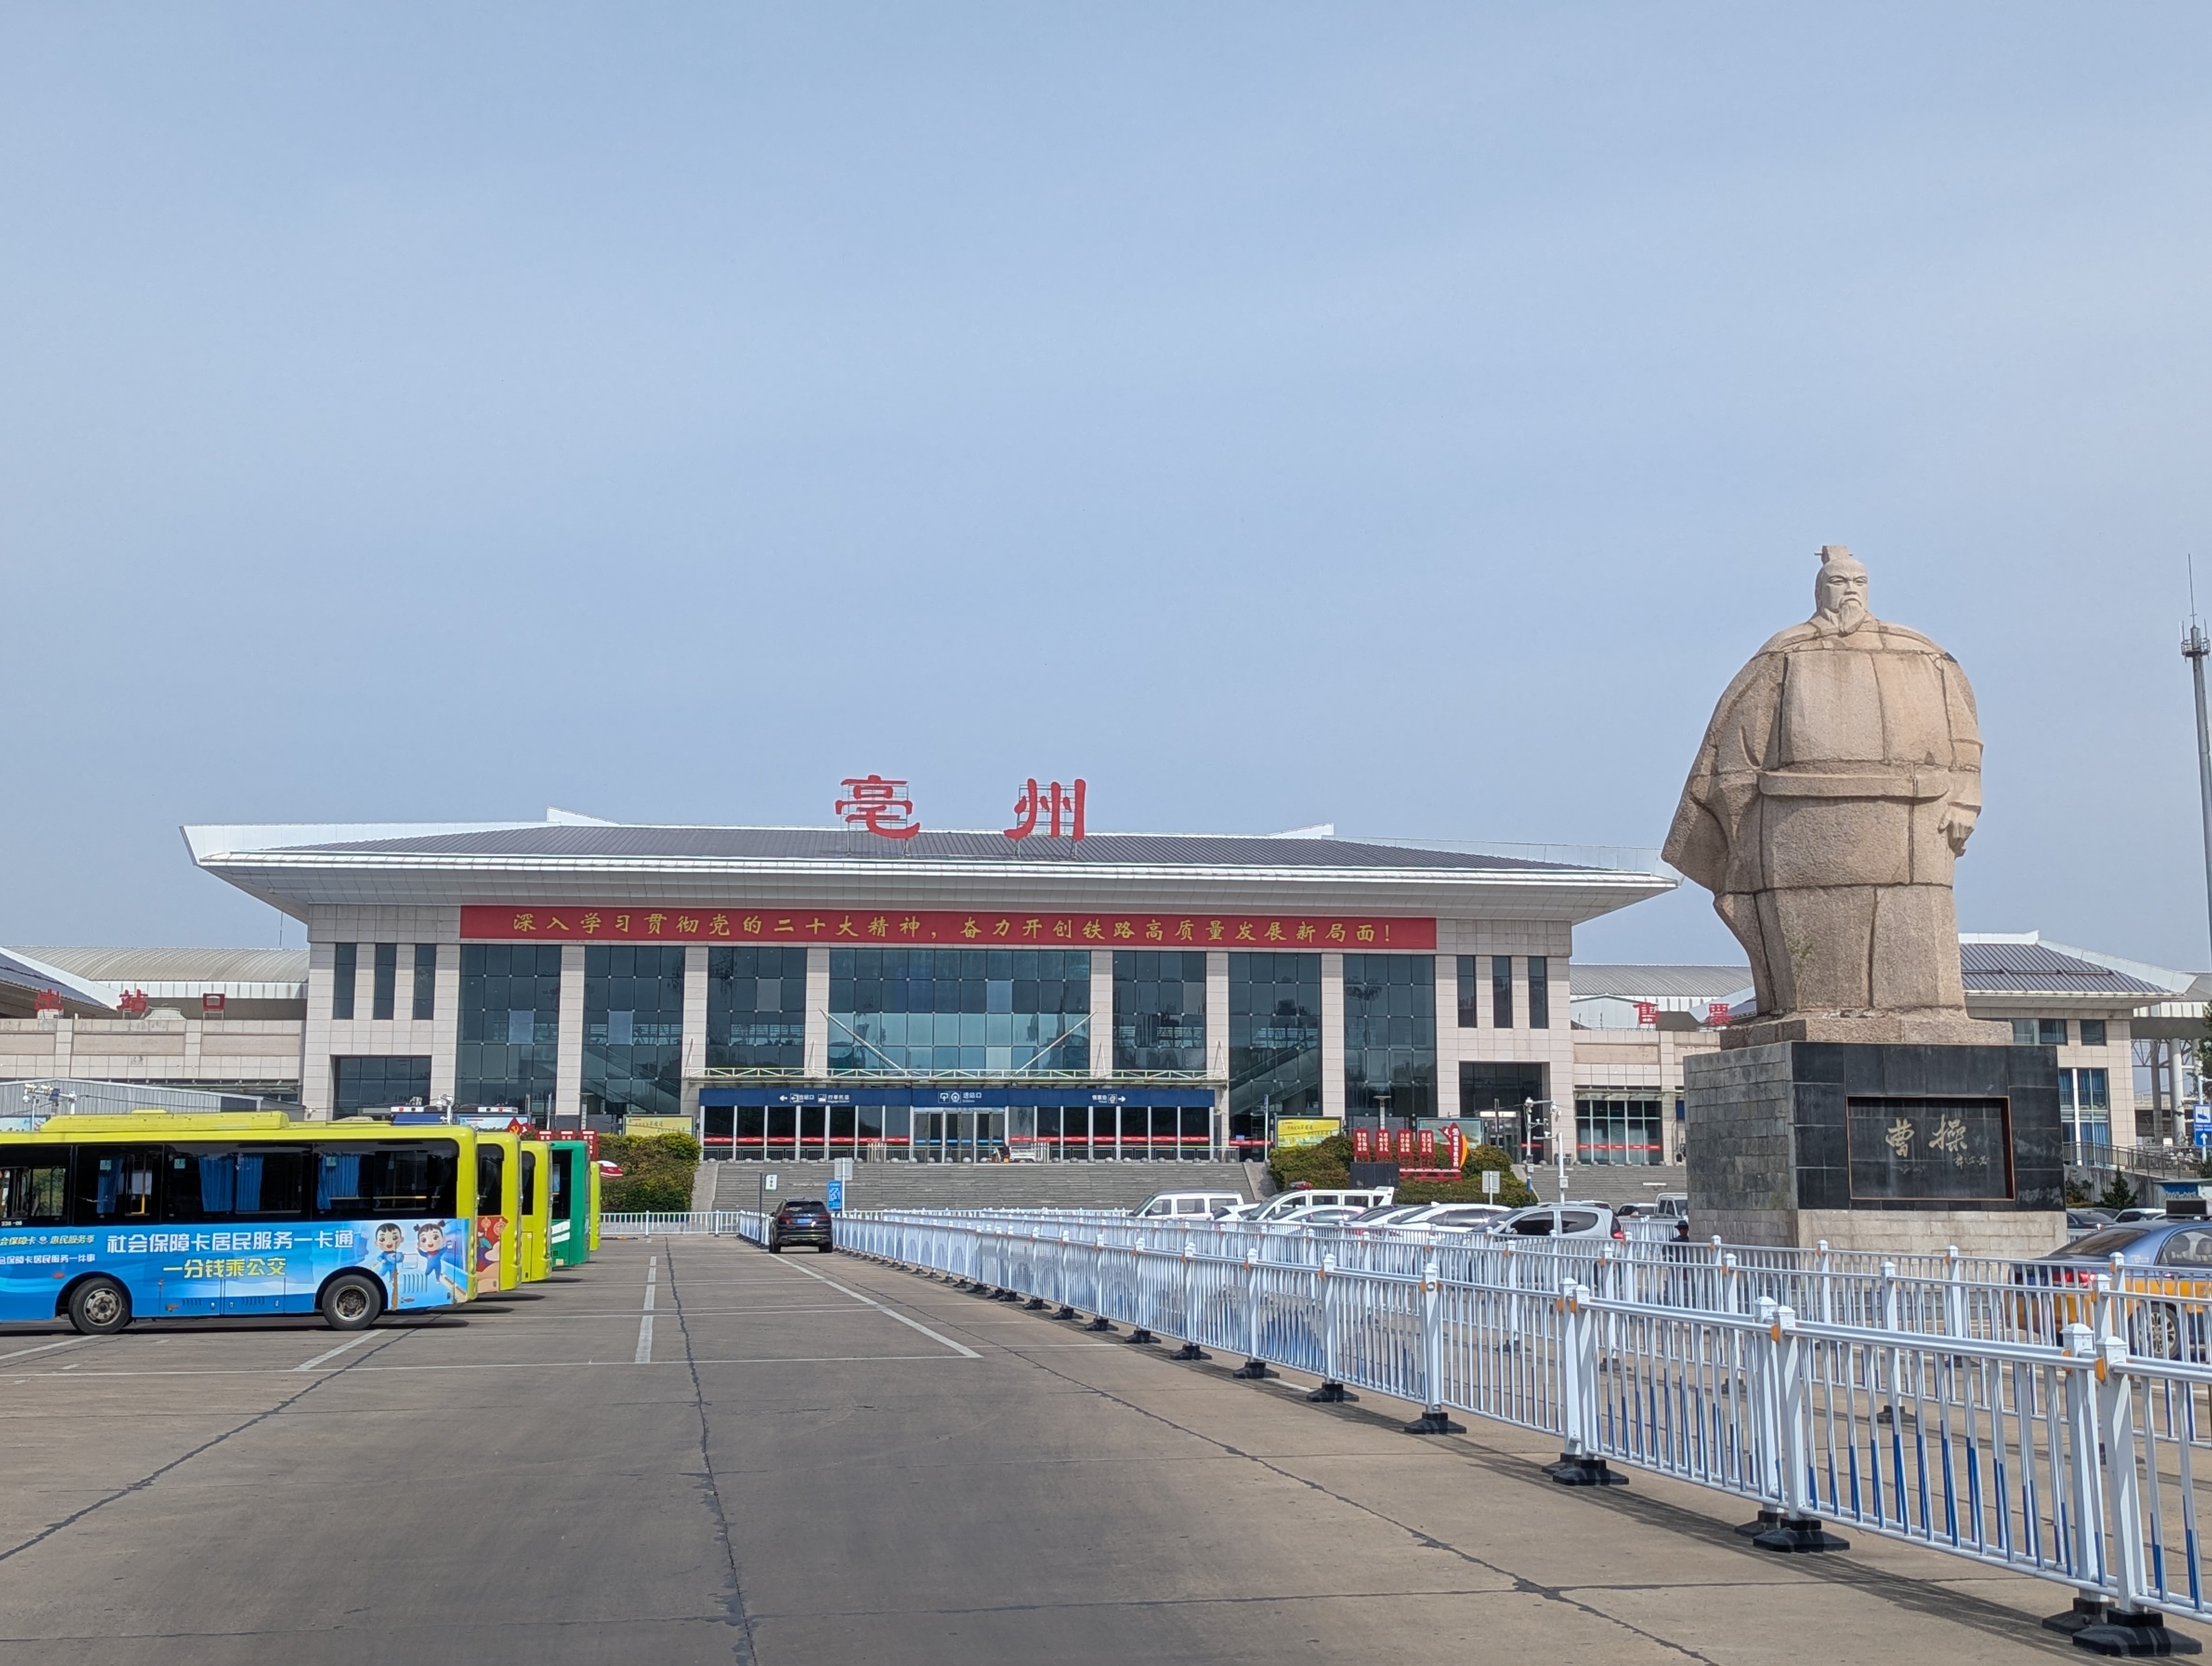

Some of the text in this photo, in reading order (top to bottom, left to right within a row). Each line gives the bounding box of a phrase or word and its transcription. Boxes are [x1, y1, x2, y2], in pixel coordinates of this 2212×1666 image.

[835, 774, 1086, 841] 亳州
[35, 989, 225, 1011] 出站口
[1885, 1114, 1967, 1157] 曹操
[107, 1229, 353, 1253] 社会保障卡居民服务一卡通
[163, 1257, 286, 1278] 一分钱乘公交
